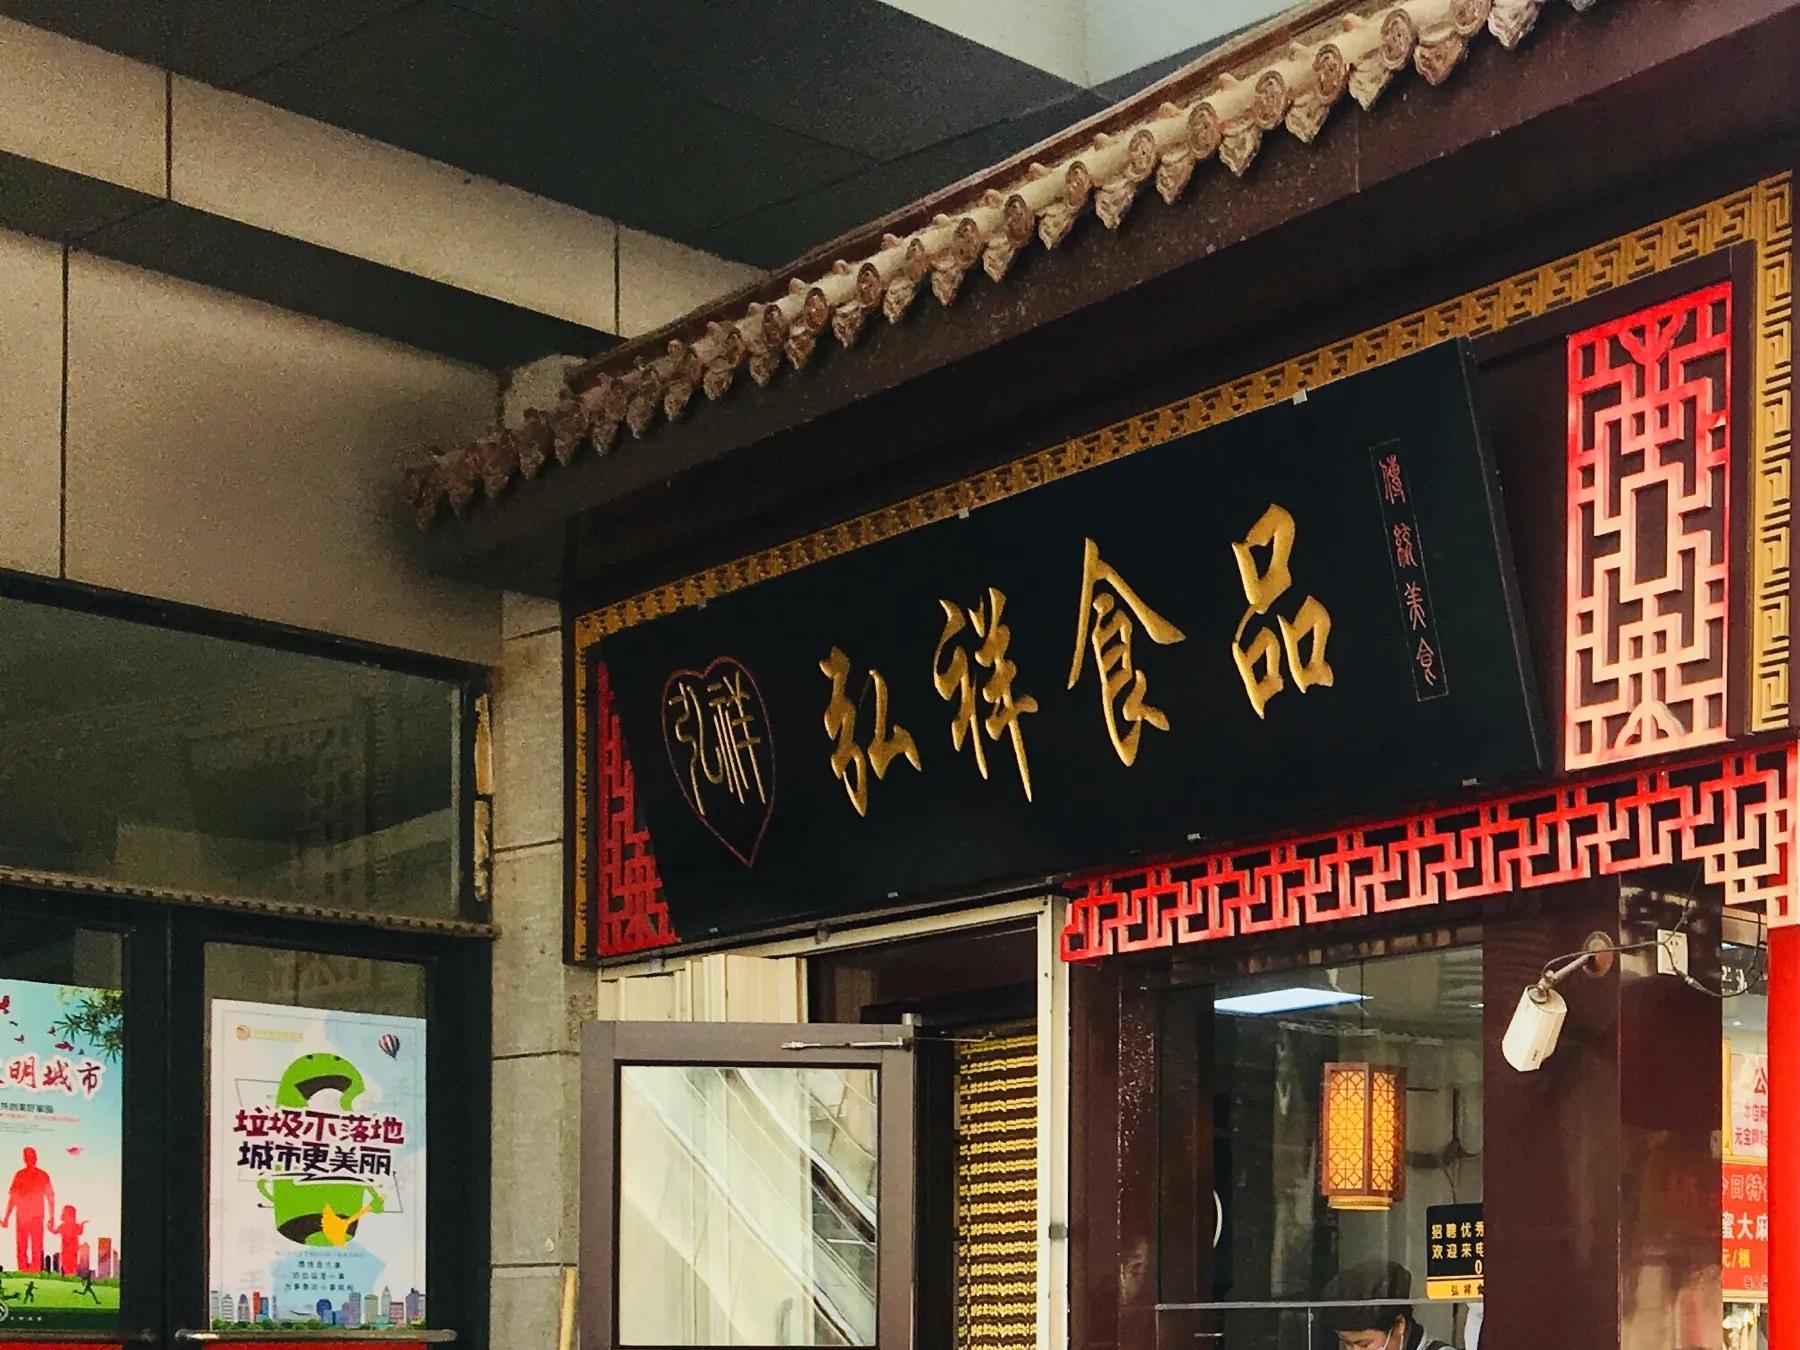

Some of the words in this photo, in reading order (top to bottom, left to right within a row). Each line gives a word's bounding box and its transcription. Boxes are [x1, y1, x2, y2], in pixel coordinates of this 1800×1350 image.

[819, 504, 1333, 817] 弘祥食品
[0, 1056, 100, 1095] 明城市
[233, 1107, 404, 1144] 垃圾不落地
[237, 1141, 391, 1175] 城市更美丽
[1432, 1221, 1484, 1239] 招聘优秀
